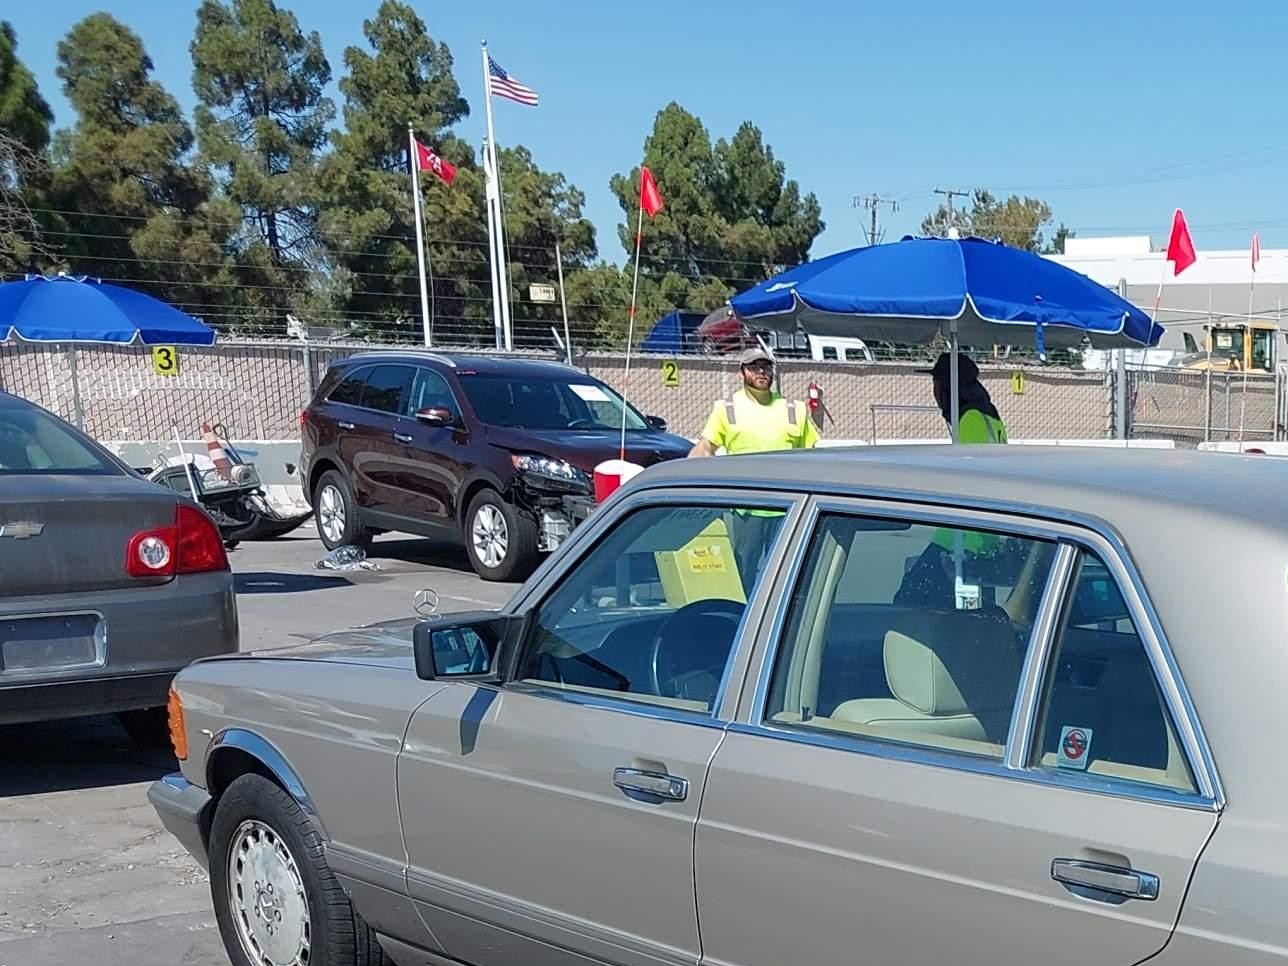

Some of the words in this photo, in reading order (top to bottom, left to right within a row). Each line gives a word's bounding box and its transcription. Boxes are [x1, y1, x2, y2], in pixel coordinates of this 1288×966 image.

[157, 348, 173, 370] 3
[665, 363, 677, 381] 2
[1015, 374, 1021, 390] 1
